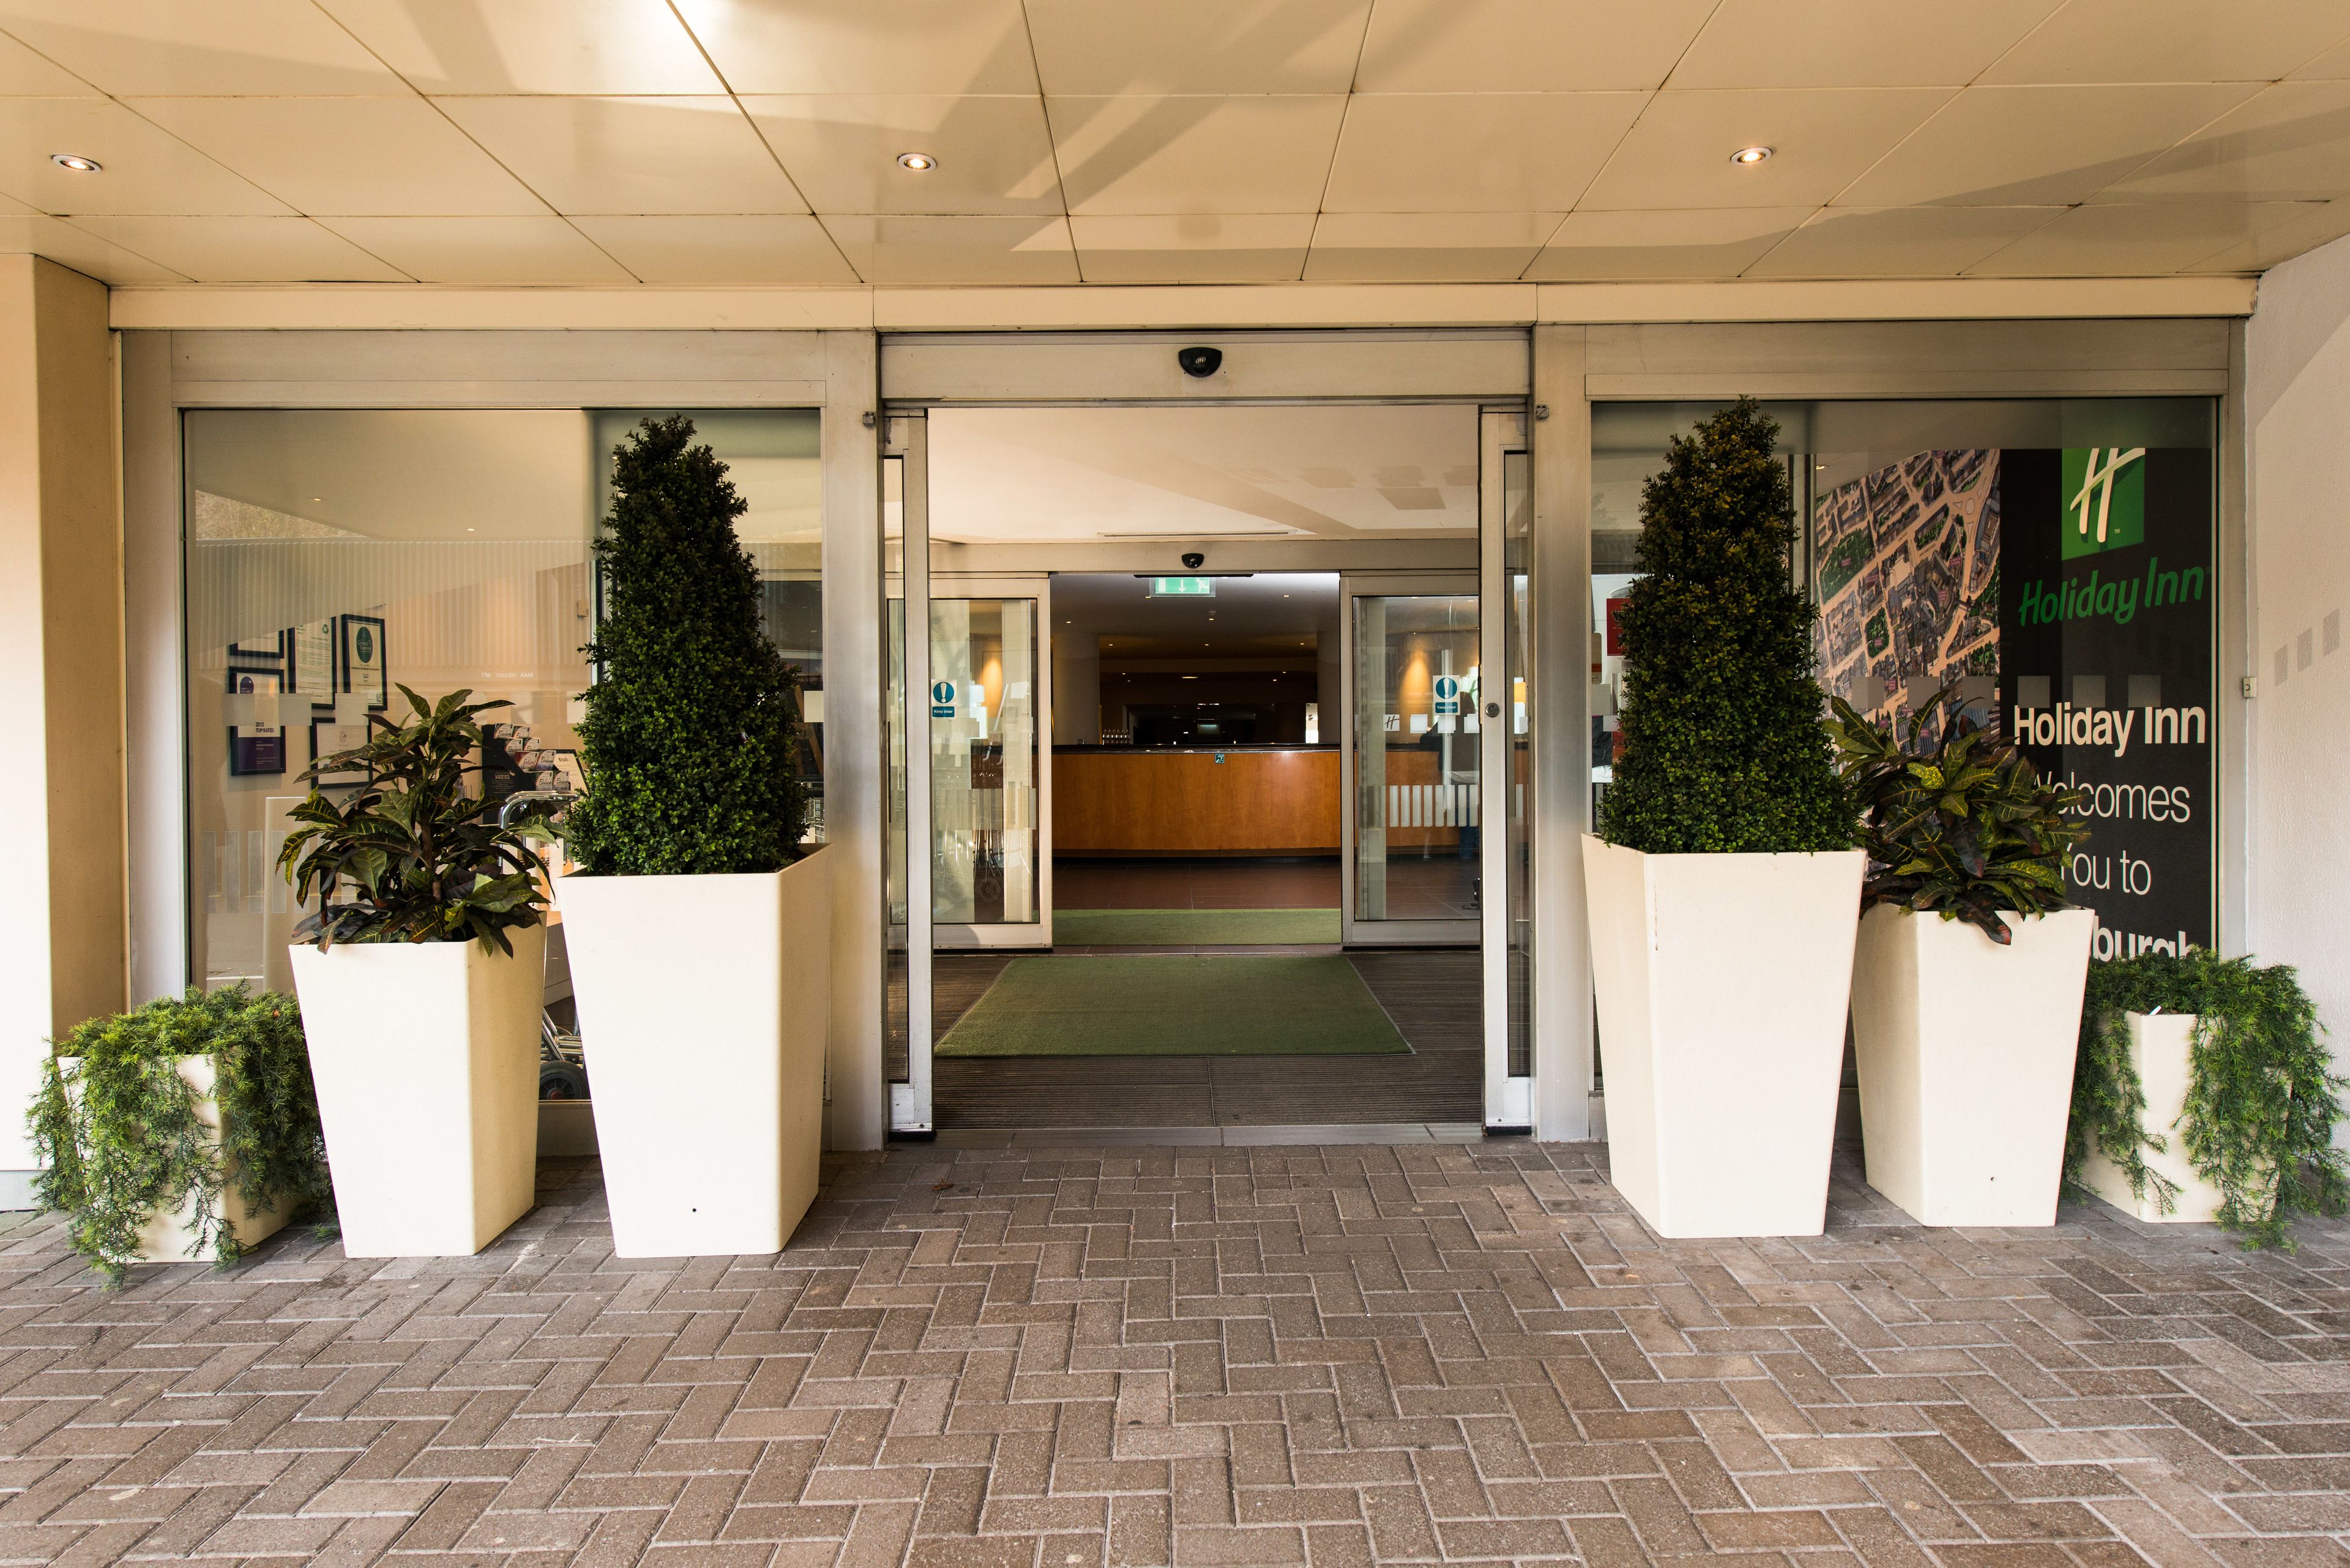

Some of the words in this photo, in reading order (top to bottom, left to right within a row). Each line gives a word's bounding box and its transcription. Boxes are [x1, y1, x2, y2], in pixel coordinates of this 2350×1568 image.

[2019, 570, 2140, 627] Holiday
[2014, 702, 2135, 758] Holiday
[2145, 706, 2206, 744] Inn
[2119, 849, 2152, 896] to
